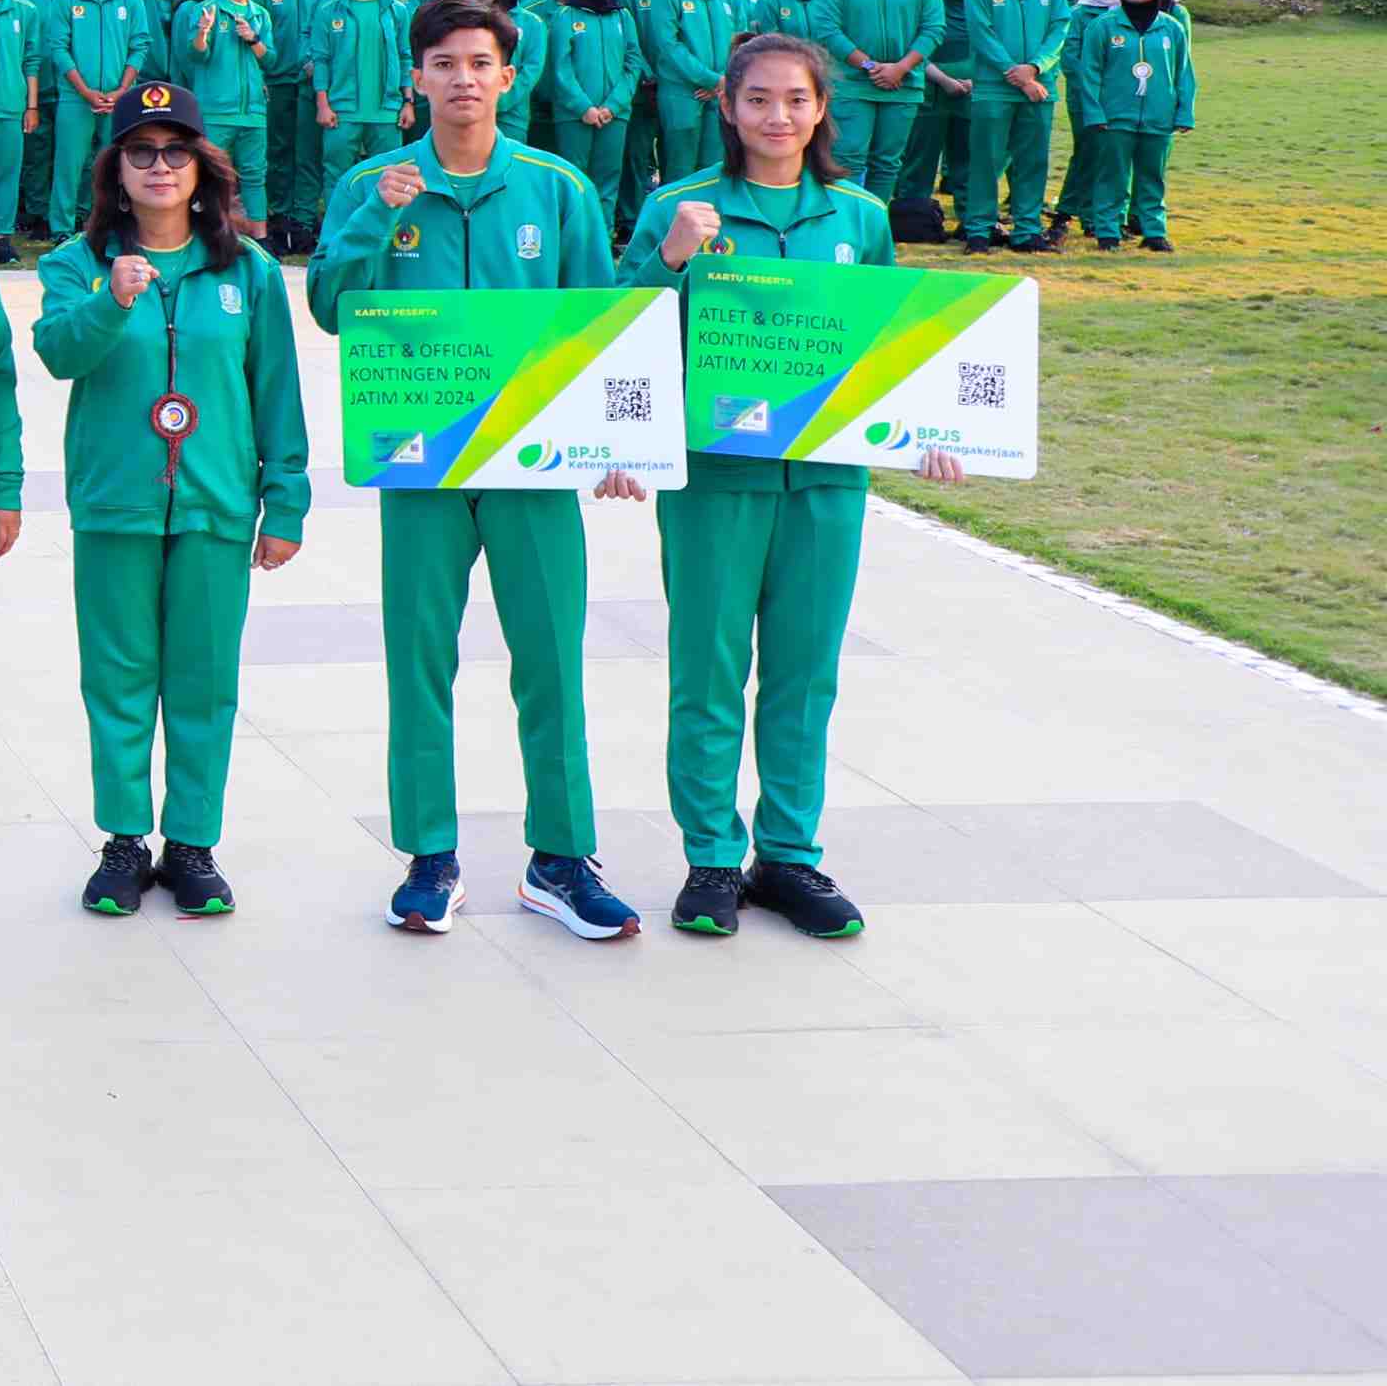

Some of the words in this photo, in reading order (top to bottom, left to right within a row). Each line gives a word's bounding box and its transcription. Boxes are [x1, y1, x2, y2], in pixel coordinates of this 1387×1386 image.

[698, 307, 747, 323] ATLET
[753, 311, 765, 325] &
[772, 313, 847, 331] OFFICIAL
[348, 344, 395, 358] ATLET
[401, 343, 414, 358] &
[420, 343, 493, 358] OFFICIAL
[699, 332, 799, 351] KONTINGEN
[806, 339, 843, 354] PON
[697, 355, 747, 371] JATIM
[753, 359, 777, 374] XXI
[784, 361, 825, 377] 2024
[350, 367, 448, 381] KONTINGEN
[455, 367, 490, 381] PON
[350, 391, 397, 405] JATIM
[404, 391, 429, 404] XXI
[435, 390, 475, 405] 2024
[917, 427, 961, 442] BPJS
[568, 447, 611, 459] BPJS
